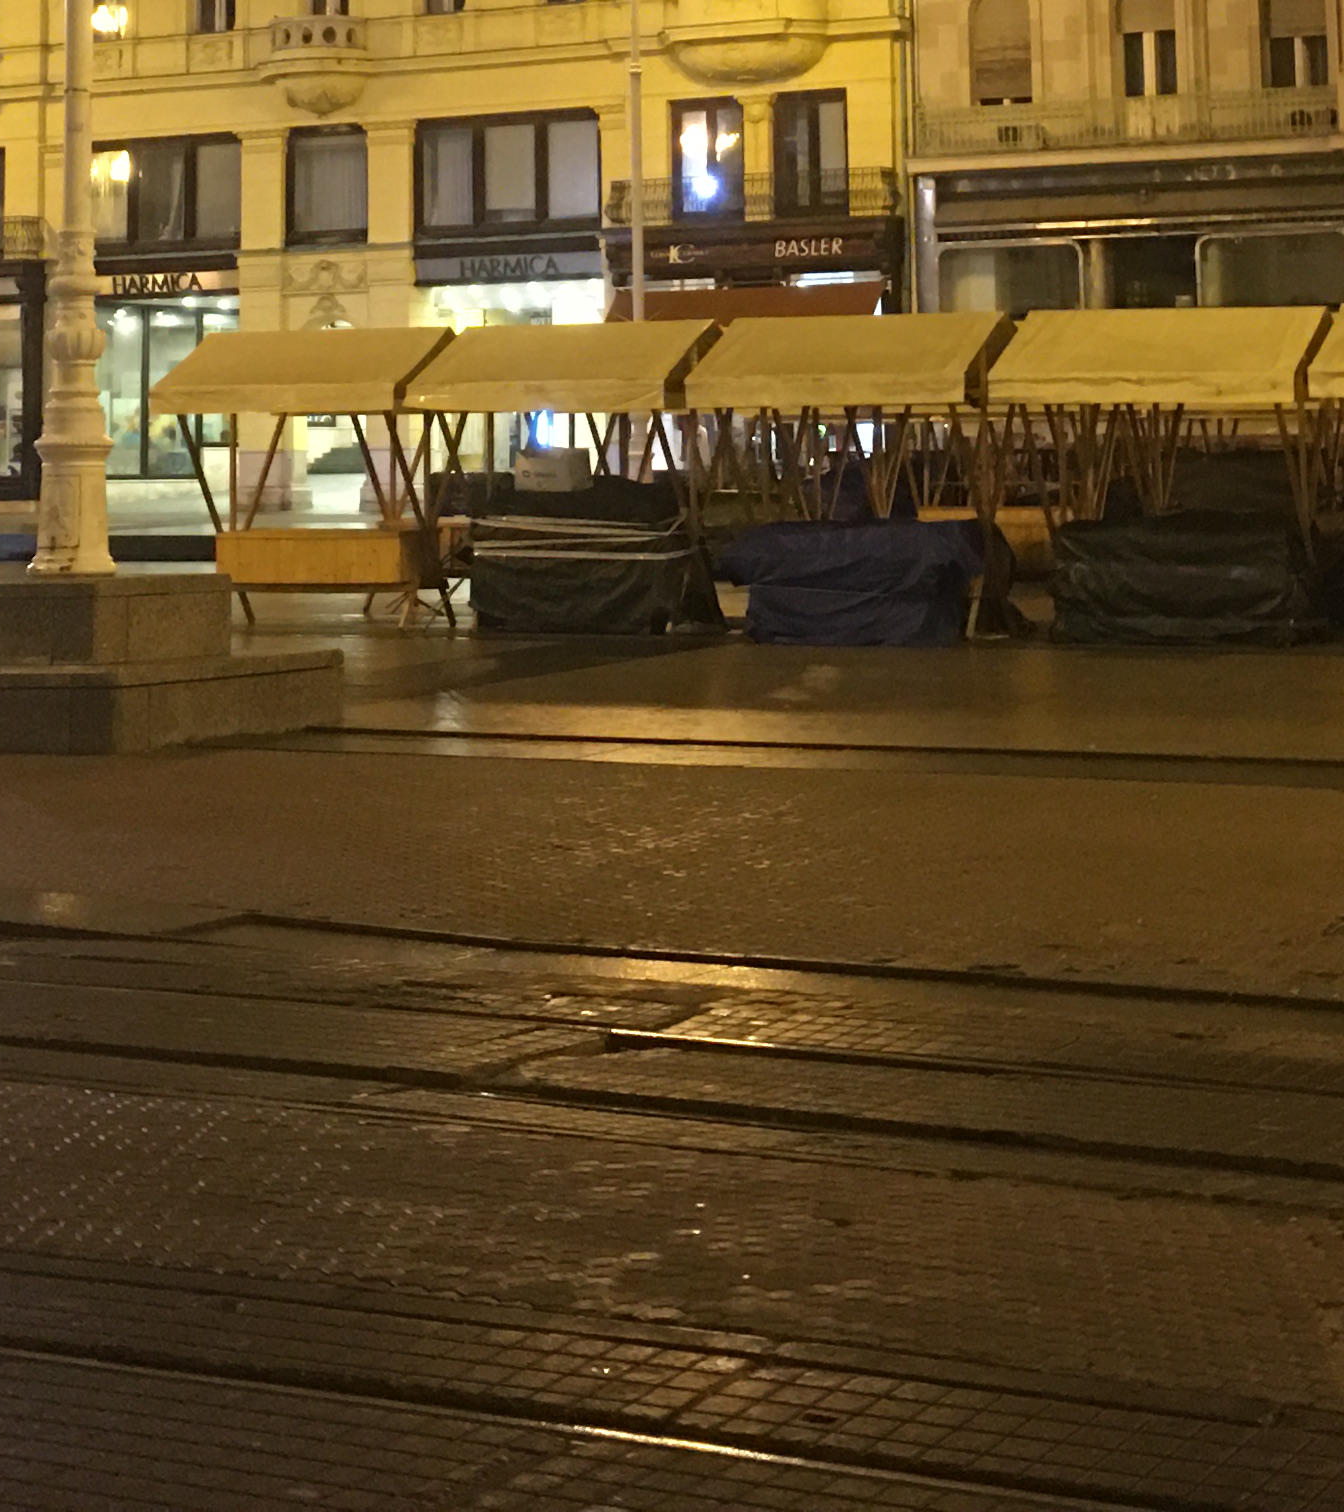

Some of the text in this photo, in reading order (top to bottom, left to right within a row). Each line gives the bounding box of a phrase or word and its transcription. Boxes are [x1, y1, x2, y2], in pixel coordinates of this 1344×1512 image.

[774, 237, 843, 258] BASLER
[459, 255, 560, 279] HARMICA
[112, 272, 204, 295] HARMICA
